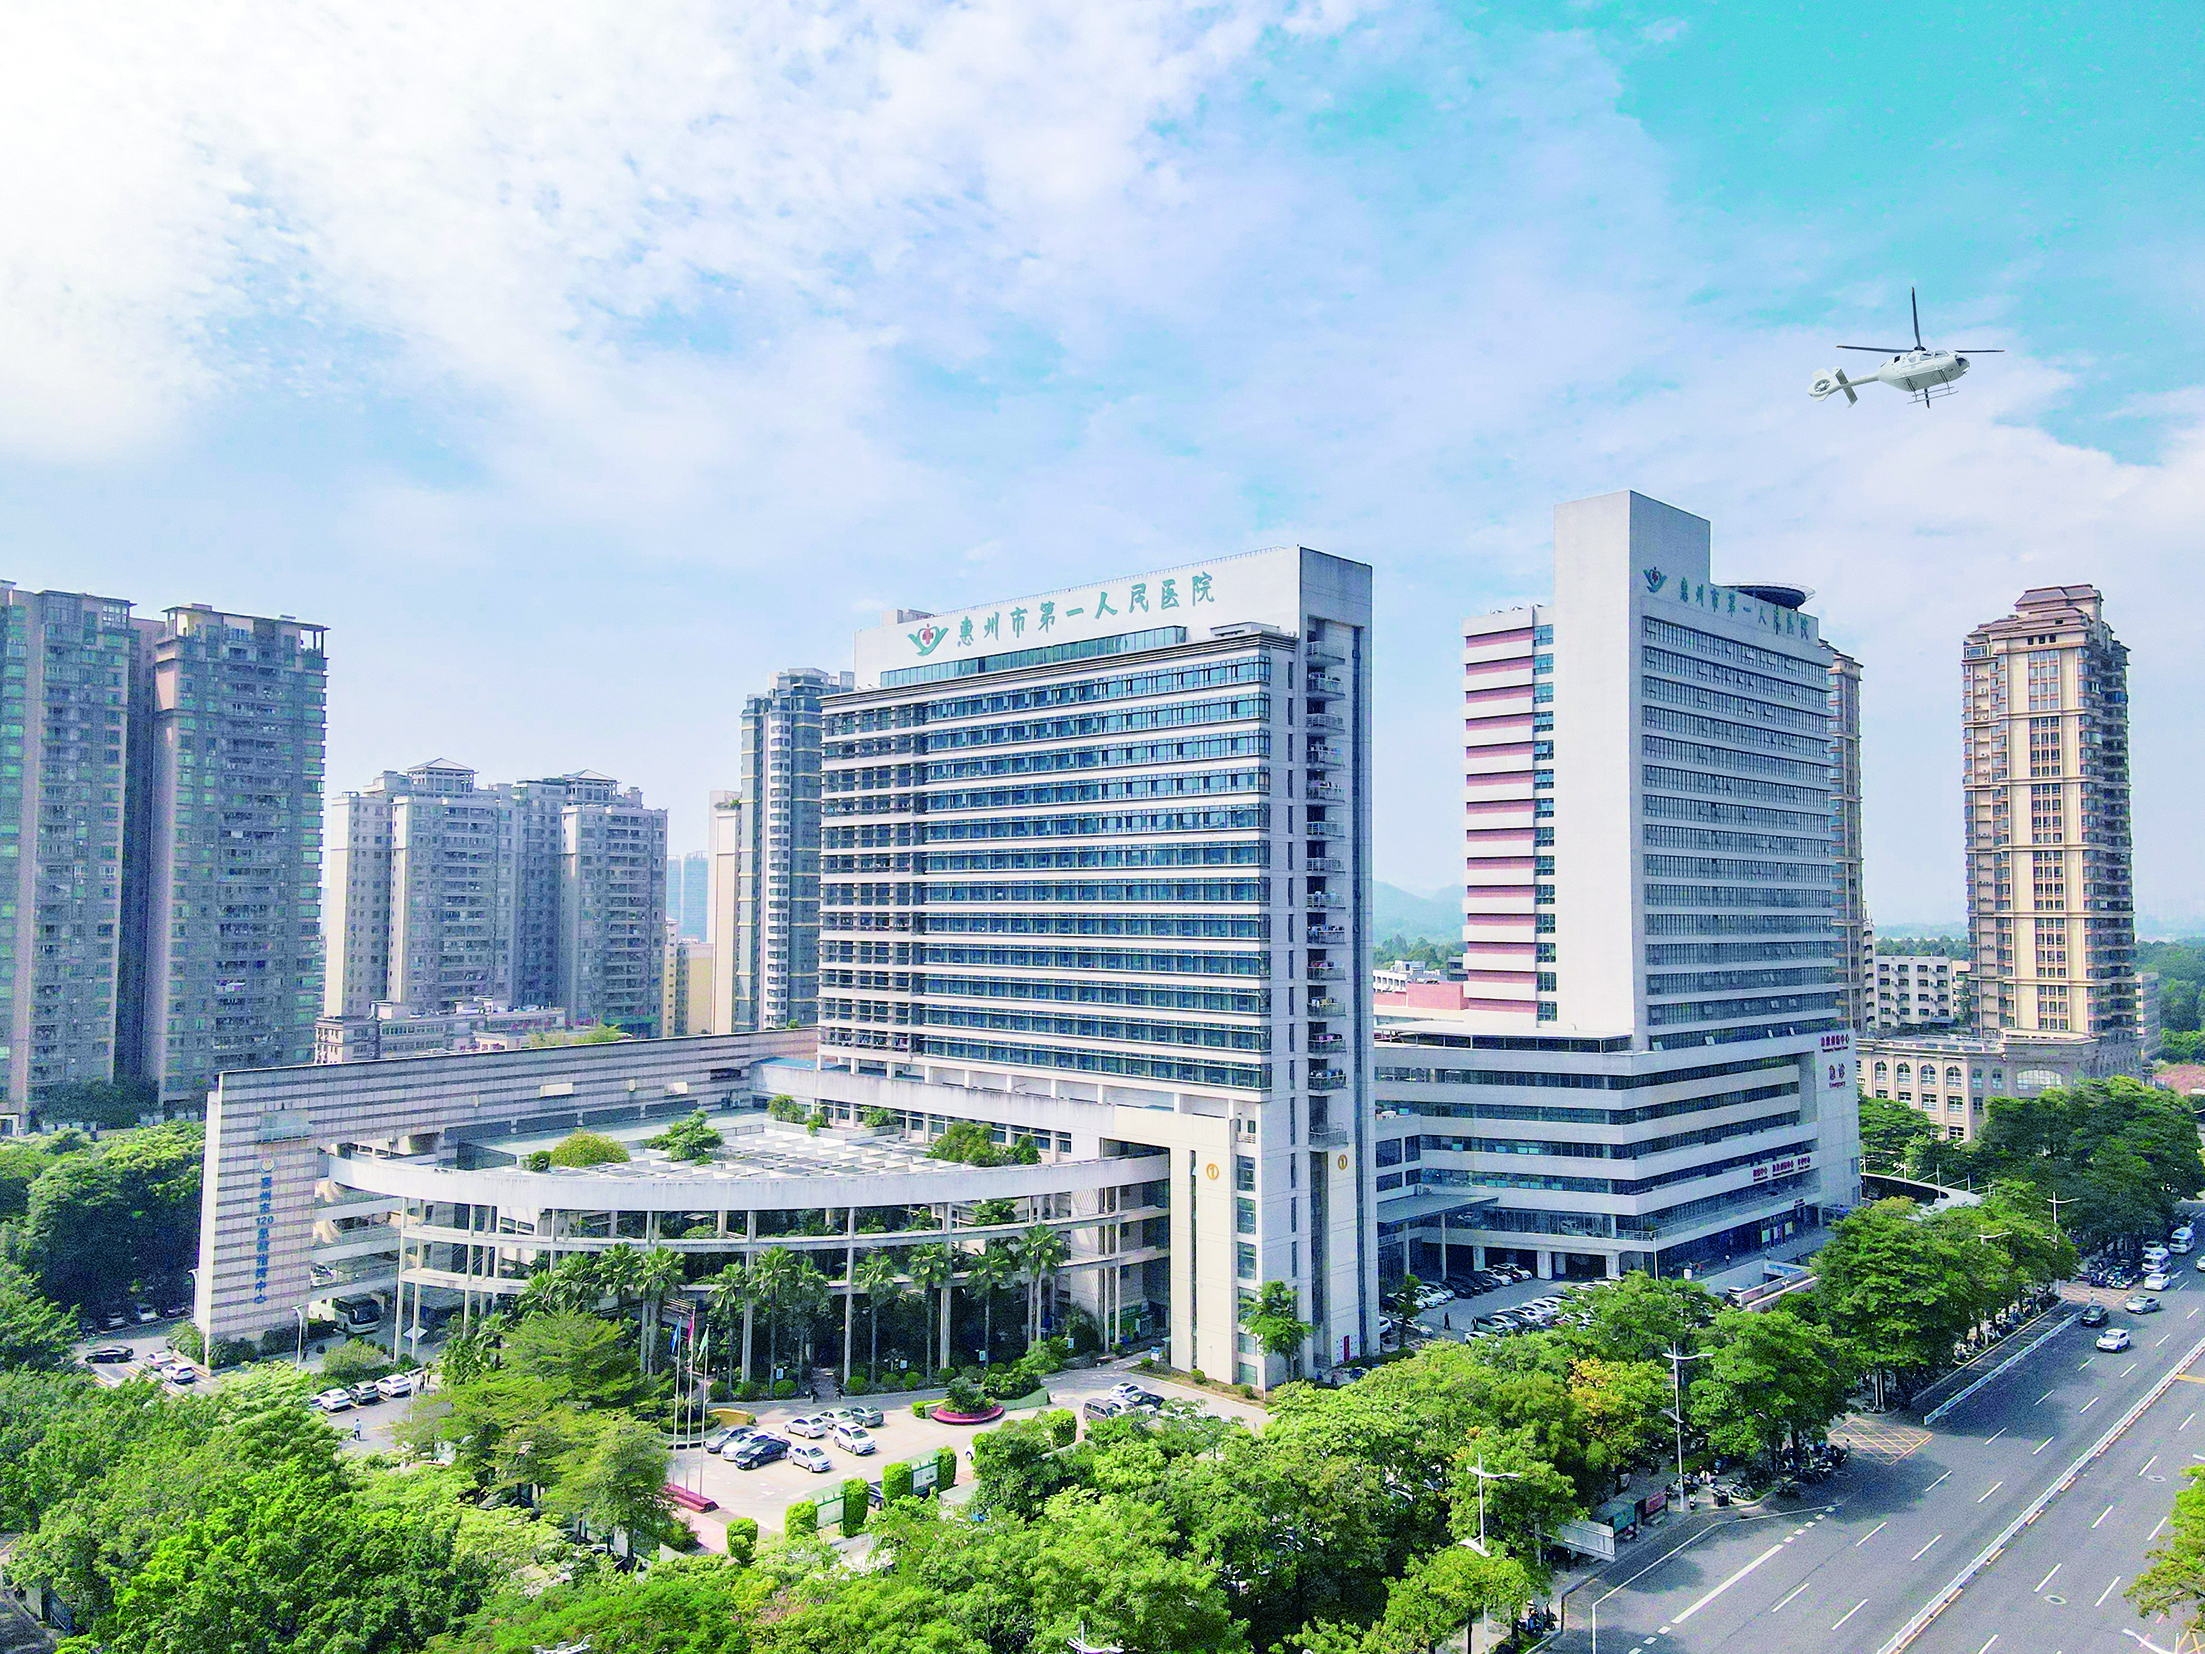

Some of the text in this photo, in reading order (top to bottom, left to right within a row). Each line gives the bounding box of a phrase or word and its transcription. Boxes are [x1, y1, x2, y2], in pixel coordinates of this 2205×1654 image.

[957, 570, 1215, 647] 惠州市第一人民医院
